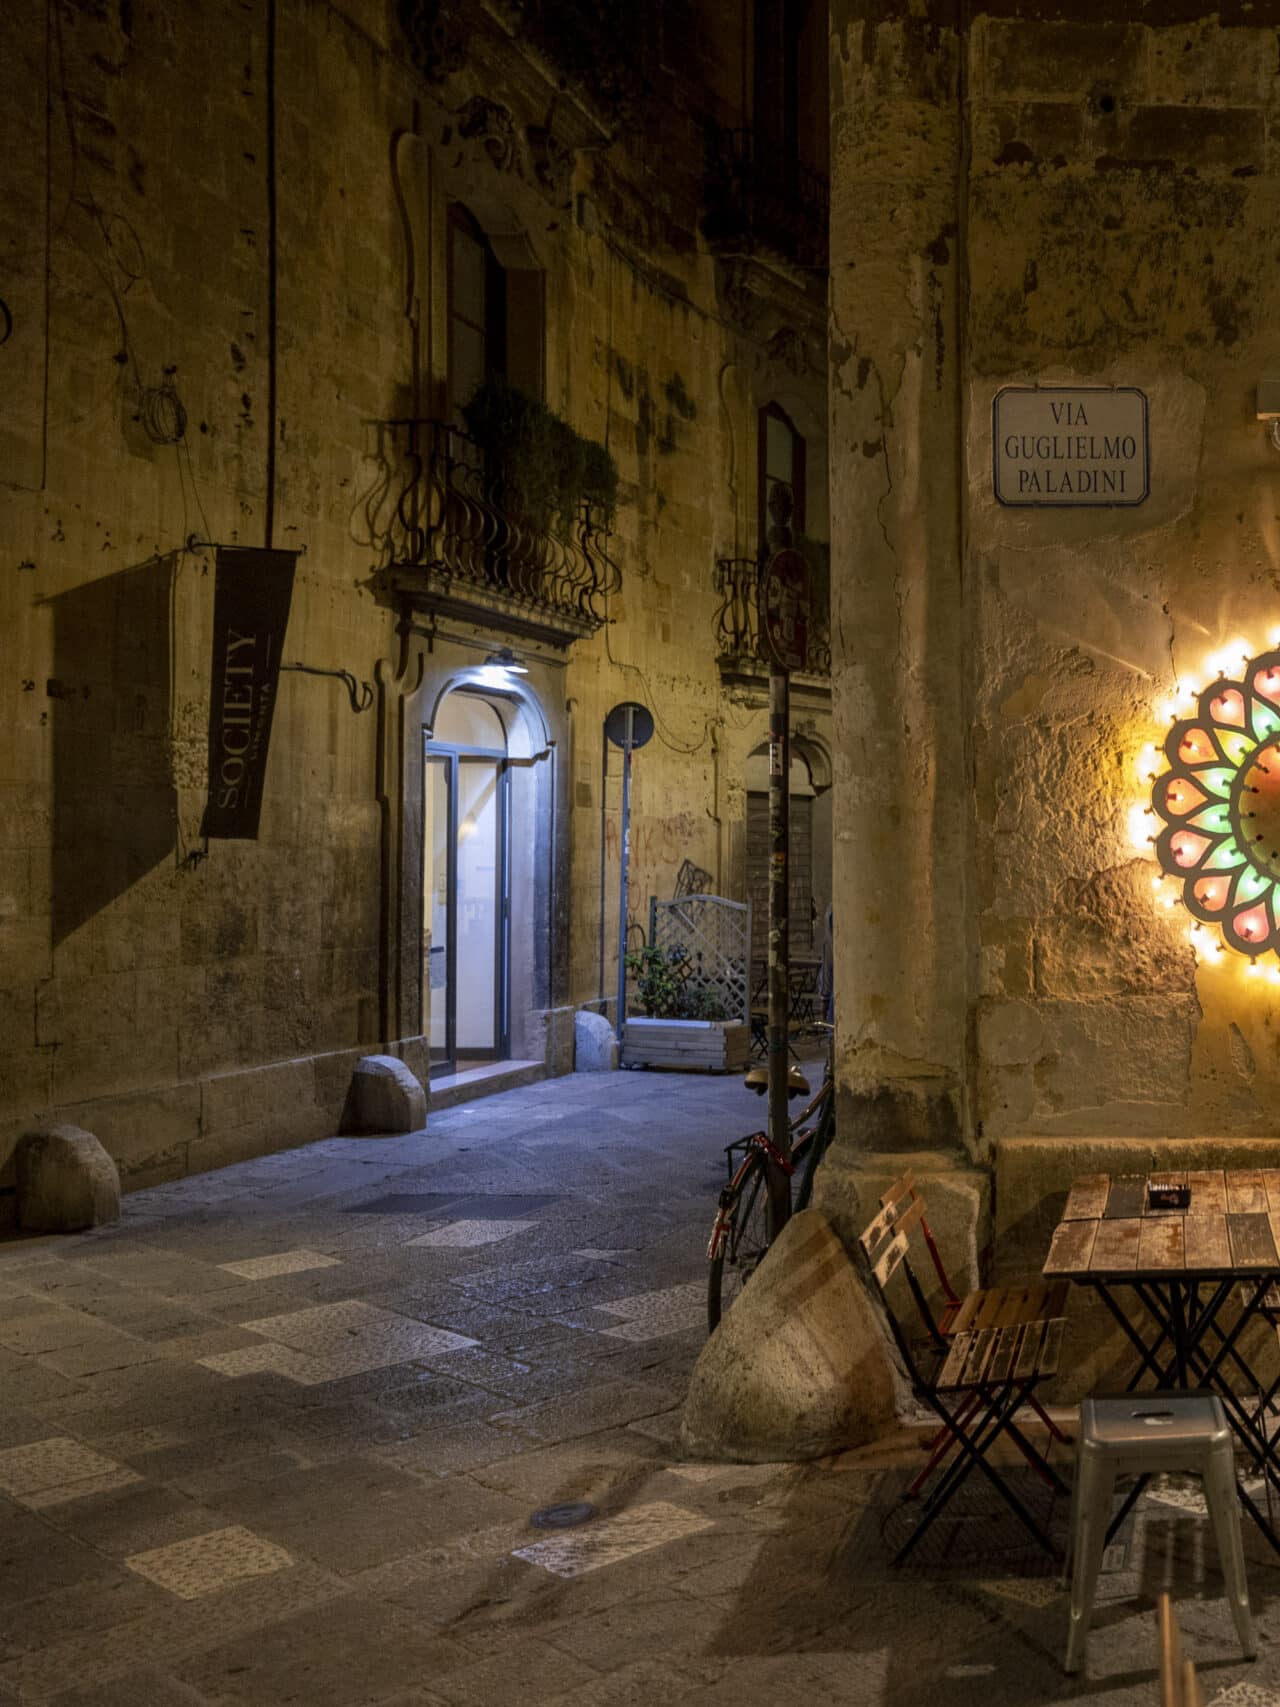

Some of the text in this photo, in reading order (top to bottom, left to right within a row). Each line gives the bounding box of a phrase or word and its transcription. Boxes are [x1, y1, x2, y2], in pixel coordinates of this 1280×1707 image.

[1051, 402, 1088, 426] VIA
[1005, 436, 1136, 460] GUGLIELMO
[1018, 469, 1126, 494] PALADINI
[217, 627, 257, 809] SOCIETY
